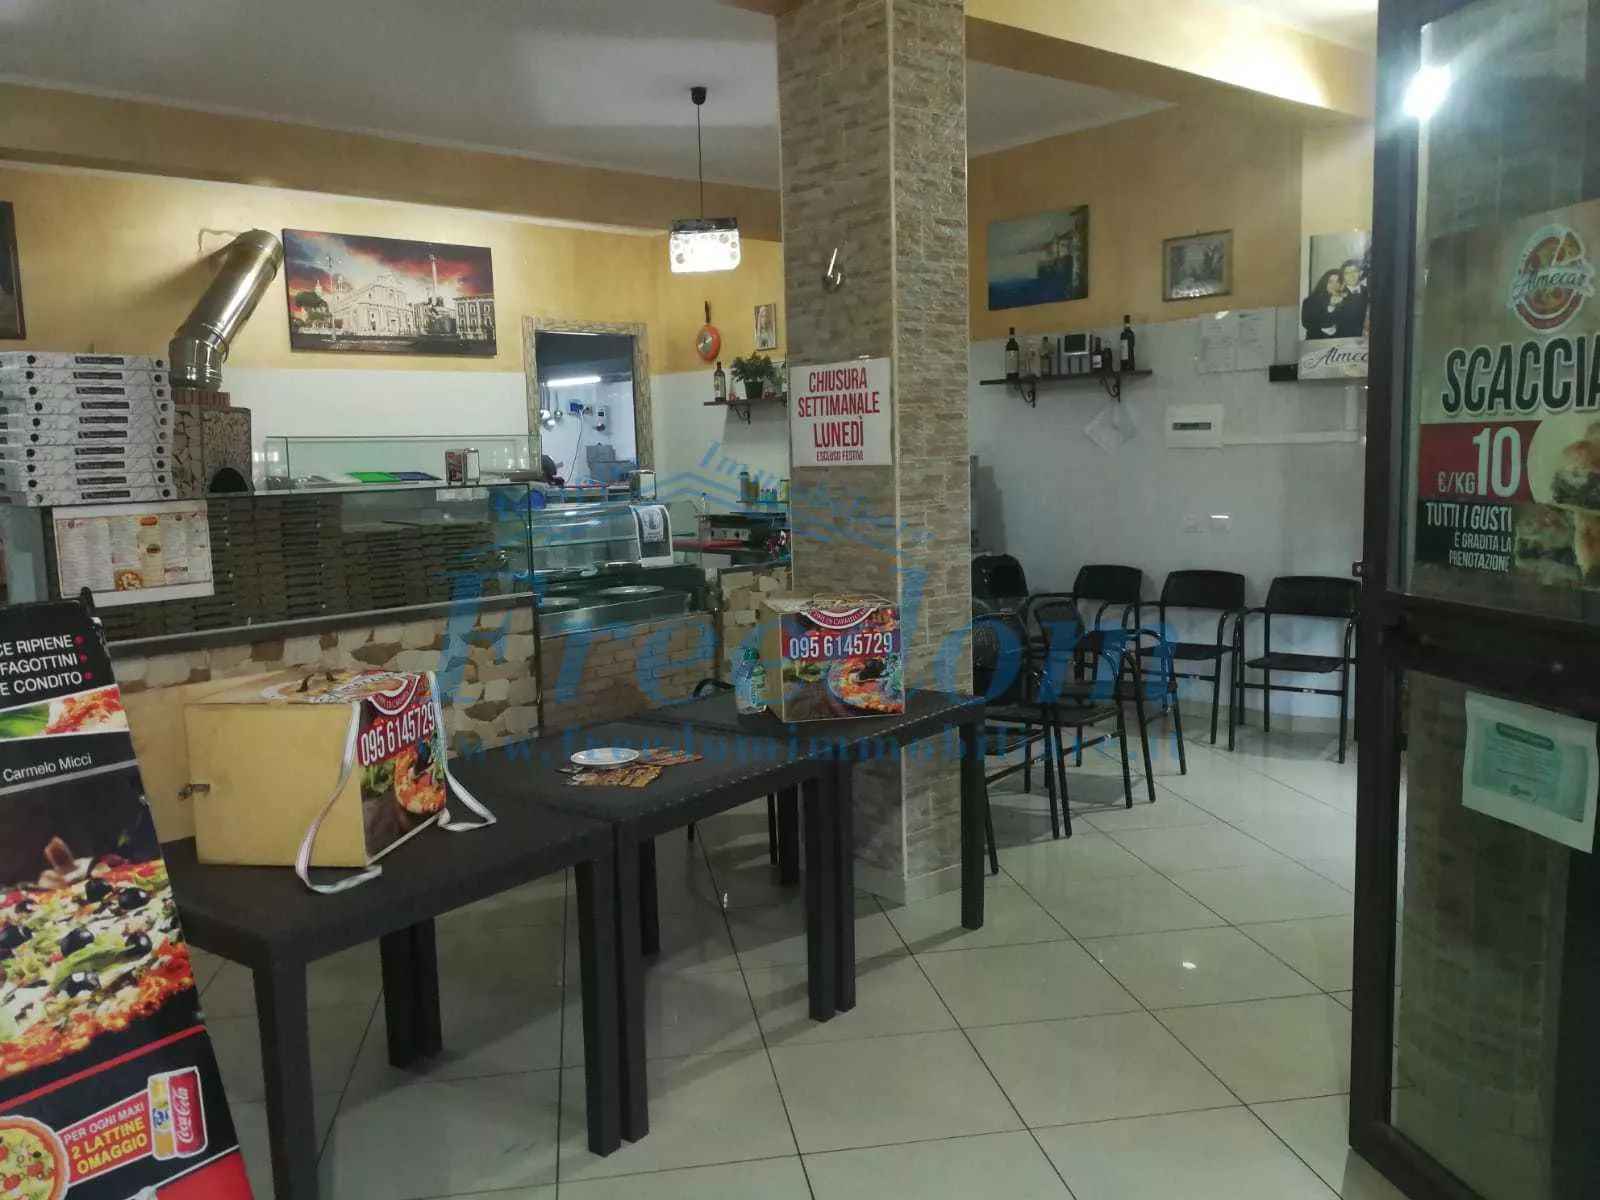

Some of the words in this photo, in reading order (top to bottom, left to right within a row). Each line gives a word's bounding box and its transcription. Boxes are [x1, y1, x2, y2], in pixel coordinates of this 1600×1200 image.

[809, 367, 867, 392] CHIUSURA
[798, 391, 880, 417] SETTIMANALE
[814, 416, 864, 448] LUNEDÌ
[1472, 427, 1521, 497] 10
[1425, 503, 1459, 528] TUTTI
[1463, 504, 1468, 528] I
[1471, 505, 1512, 532] GUSTI
[1462, 532, 1499, 552] GRADITA
[1501, 535, 1511, 552] LA
[1449, 550, 1510, 572] PRENOTAZIONE
[16, 634, 73, 654] RIPIENE
[790, 636, 819, 659] 095
[823, 632, 893, 656] 6145729
[0, 653, 78, 676] FAGOTTINI
[14, 671, 82, 693] CONDITO
[361, 726, 385, 766] 095
[386, 701, 436, 752] 6145729
[3, 762, 56, 782] Carmelo
[58, 752, 92, 770] Micci
[63, 1127, 87, 1144] PER
[89, 1114, 117, 1133] OGNI
[118, 1102, 145, 1121] MAXI
[71, 1146, 81, 1160] 2
[84, 1117, 145, 1153] LATTINE
[77, 1133, 147, 1174] OMAGGIO
